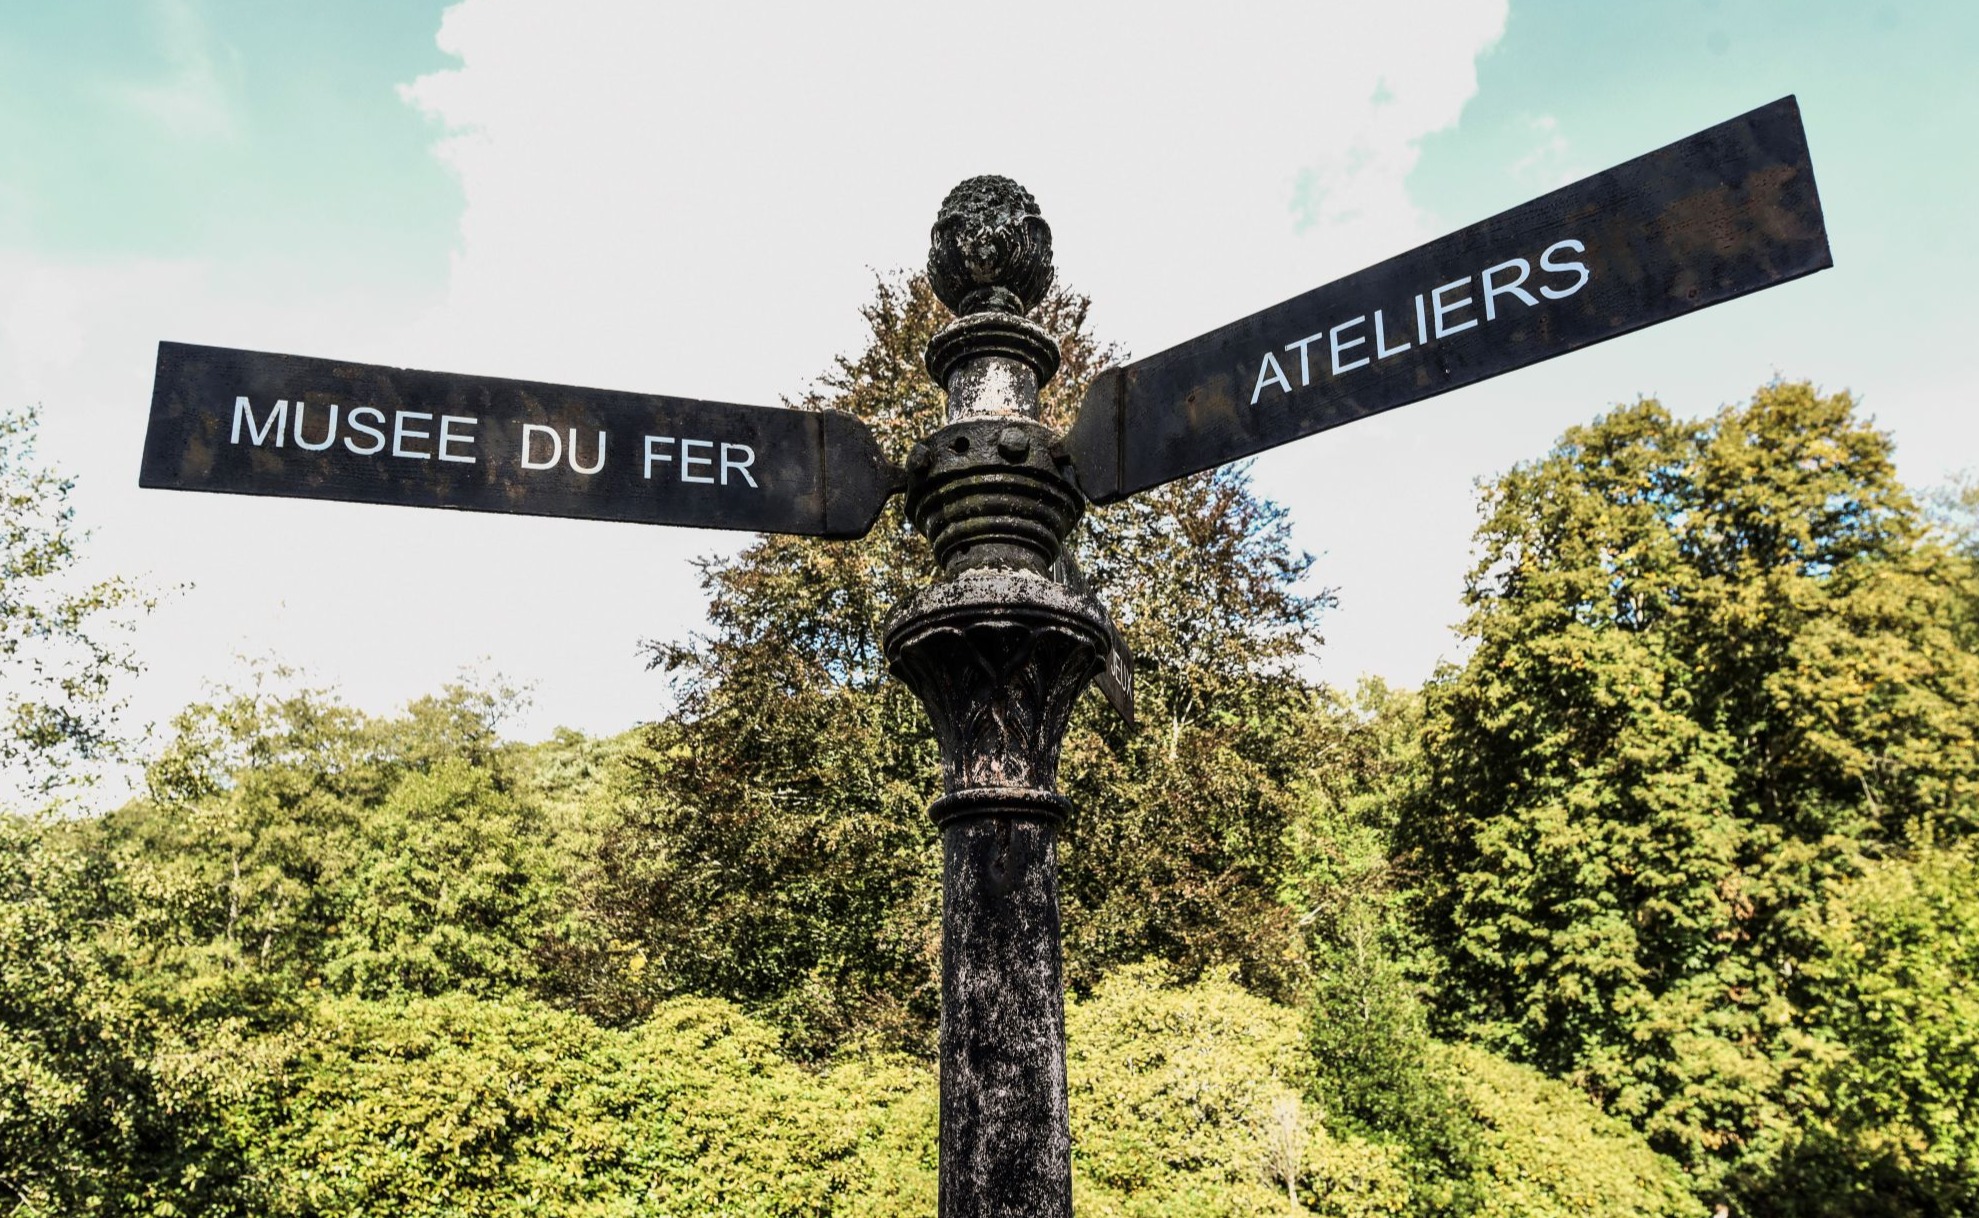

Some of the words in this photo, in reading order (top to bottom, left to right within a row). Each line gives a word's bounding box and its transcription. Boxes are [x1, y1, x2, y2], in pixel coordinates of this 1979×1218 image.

[1250, 239, 1590, 405] ATELIERS
[230, 396, 478, 464] MUSEE
[520, 423, 606, 475] DU
[643, 434, 758, 488] FER
[1110, 648, 1132, 701] JEUX
